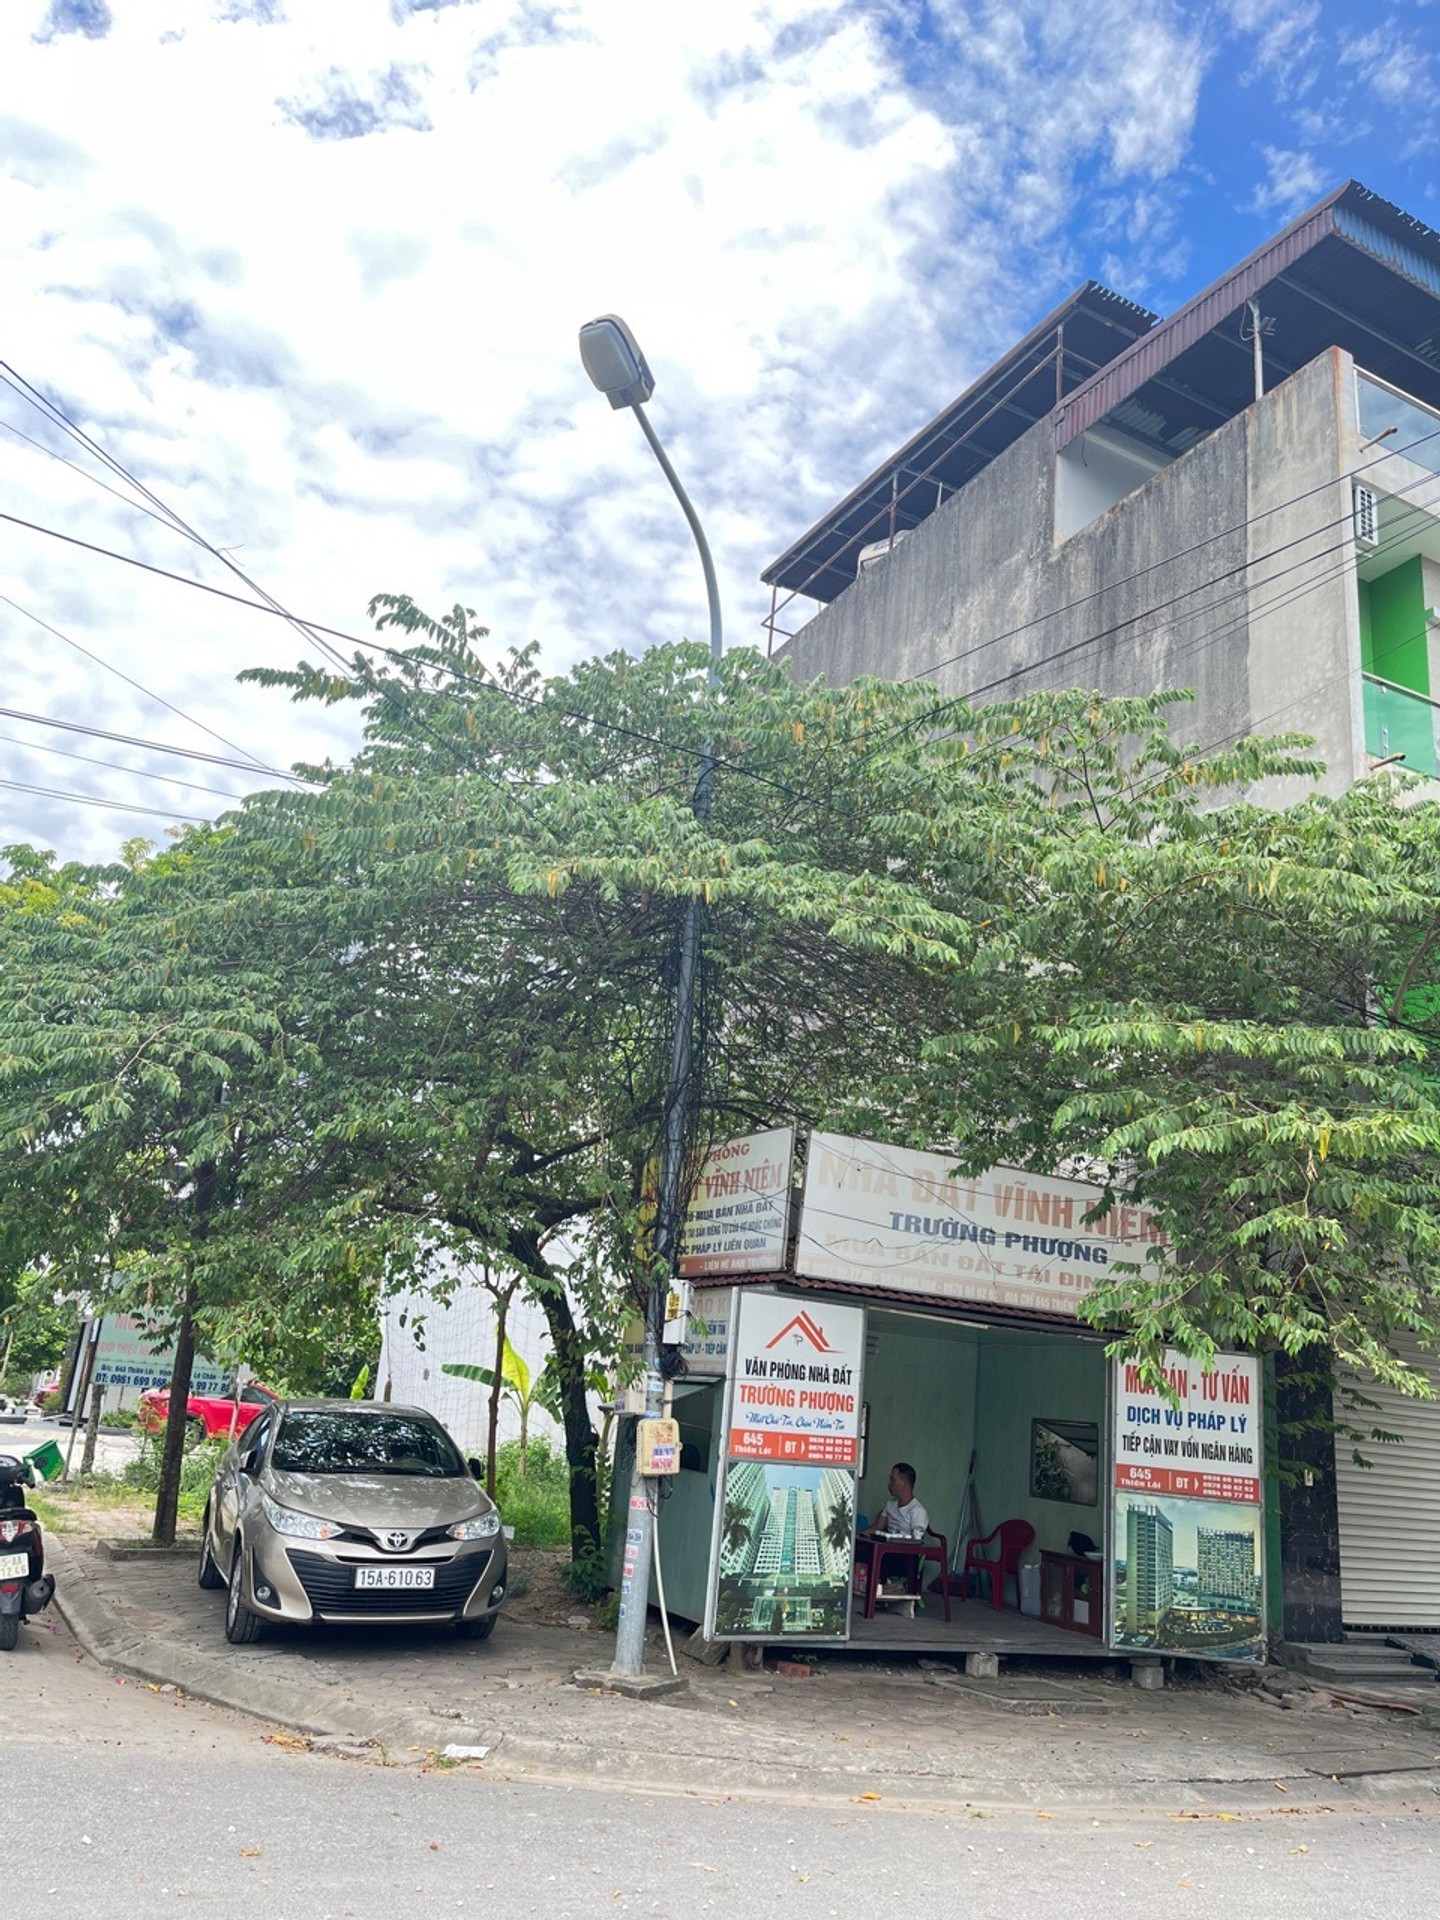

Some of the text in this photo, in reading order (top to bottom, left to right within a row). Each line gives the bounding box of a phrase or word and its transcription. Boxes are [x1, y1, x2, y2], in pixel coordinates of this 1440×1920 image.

[993, 1180, 1073, 1230] VĨNH
[889, 1210, 1109, 1265] TRƯỜNG PHƯỢNG
[745, 1356, 853, 1386] VĂN PHÒNG NHÀ ĐẤT
[1200, 1370, 1220, 1402] TƯ
[1221, 1364, 1250, 1405] VẤN
[740, 1383, 855, 1416] TRƯỜNG PHƯỢNG
[1126, 1405, 1248, 1434] DỊCH VỤ PHÁP LÝ
[743, 1431, 764, 1446] 645
[1122, 1430, 1254, 1465] TIẾP CẬN VAY VỐN NGÂN HÀNG
[1129, 1467, 1152, 1481] 645
[361, 1570, 432, 1586] 15A-610.63
